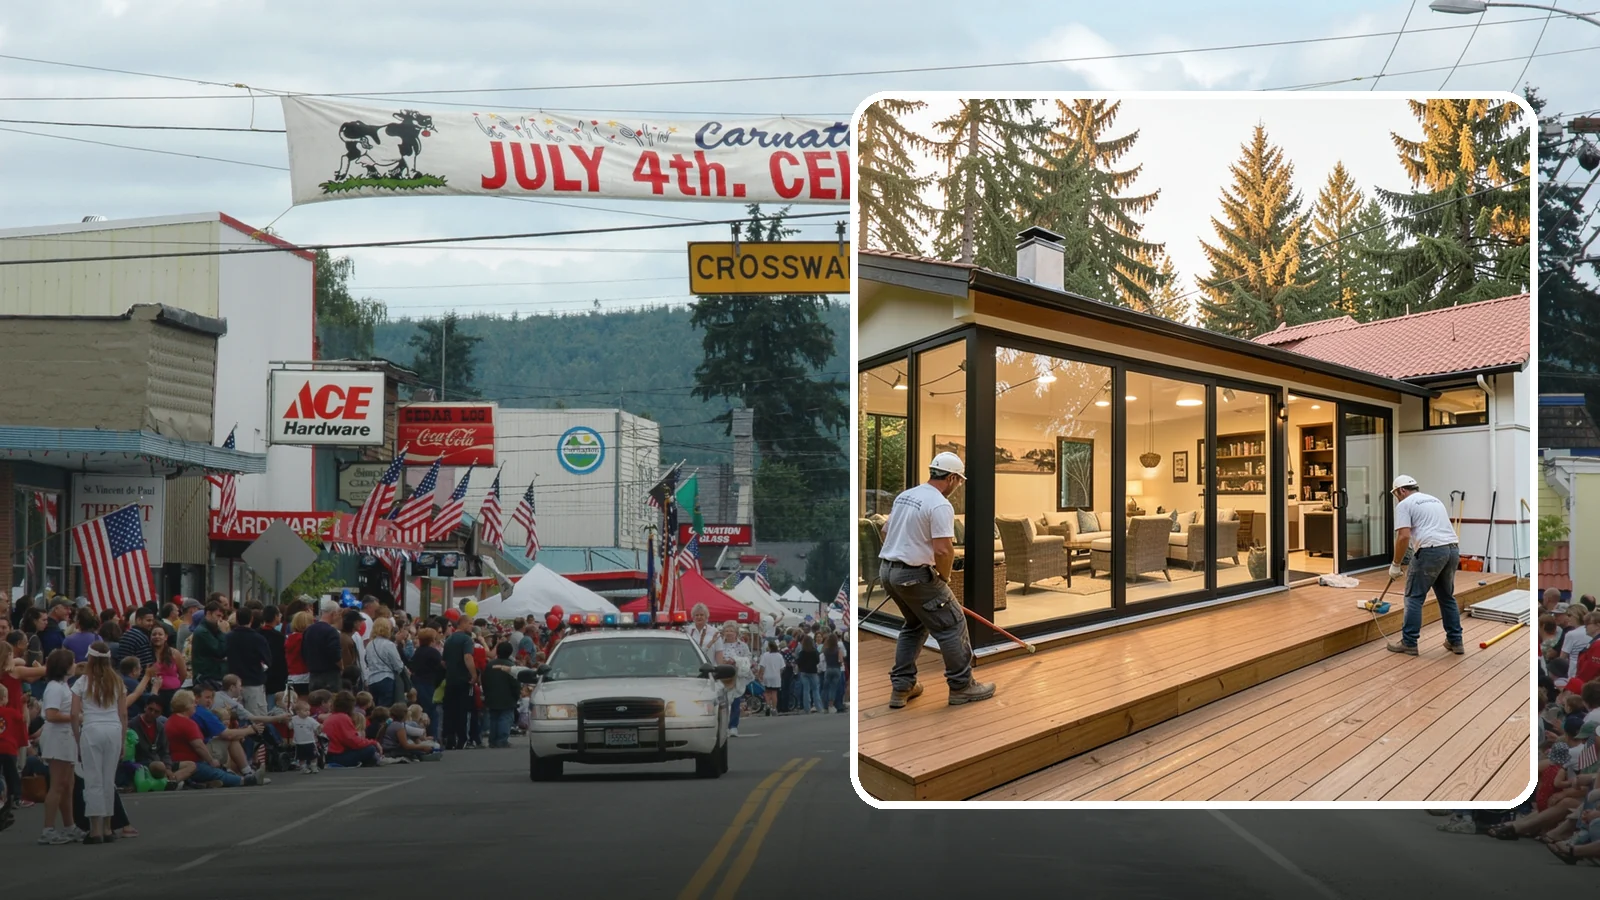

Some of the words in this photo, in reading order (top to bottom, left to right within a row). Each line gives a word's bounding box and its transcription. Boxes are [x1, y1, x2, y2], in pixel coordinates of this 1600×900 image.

[481, 141, 605, 193] JULY
[632, 149, 746, 198] 4th.
[697, 254, 850, 280] CROSSWA
[283, 380, 374, 420] ACE
[405, 409, 453, 422] CEDAR
[460, 409, 485, 422] LOG
[283, 421, 371, 436] Hardware
[416, 428, 477, 447] Coca-Cola
[95, 485, 124, 495] Vincent
[126, 486, 136, 495] de
[137, 486, 155, 496] Paul
[212, 515, 331, 536] HARDARE
[688, 526, 742, 535] CRNATION
[699, 535, 730, 544] GLASS
